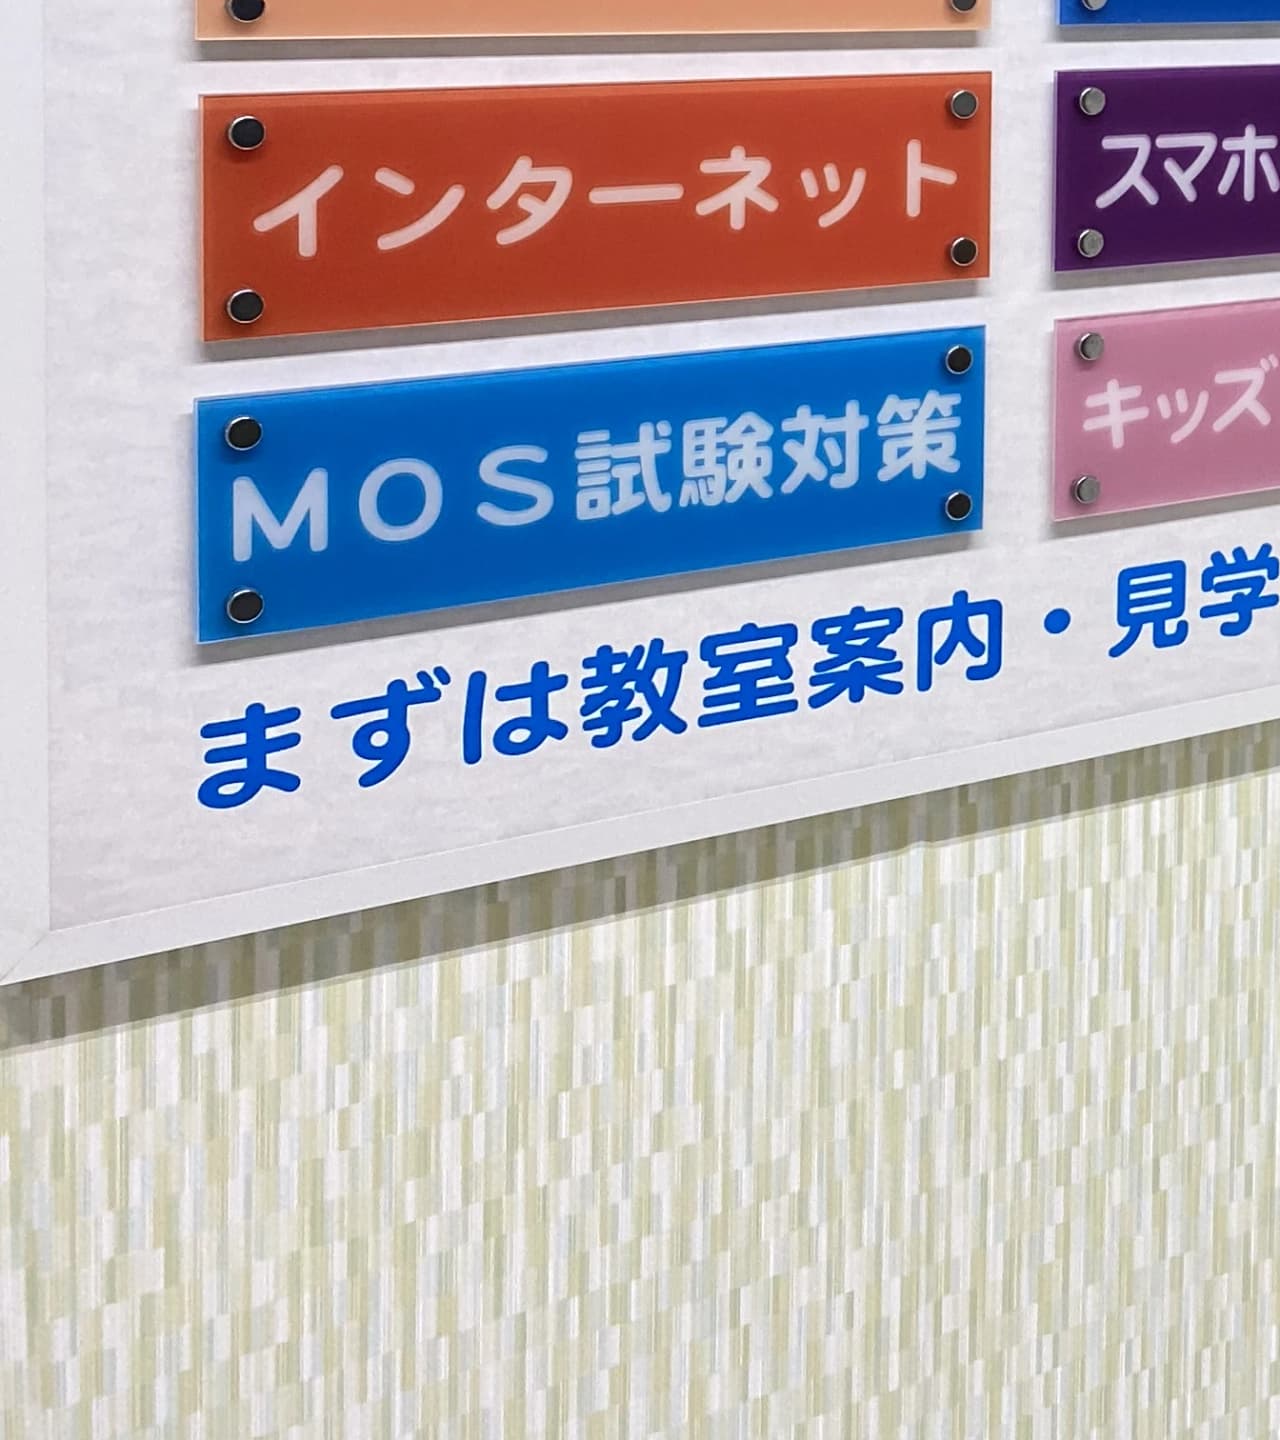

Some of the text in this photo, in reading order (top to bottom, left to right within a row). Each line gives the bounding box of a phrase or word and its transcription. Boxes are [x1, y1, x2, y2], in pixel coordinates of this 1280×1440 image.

[253, 138, 957, 257] インターネット
[231, 389, 962, 562] MOS試験対策
